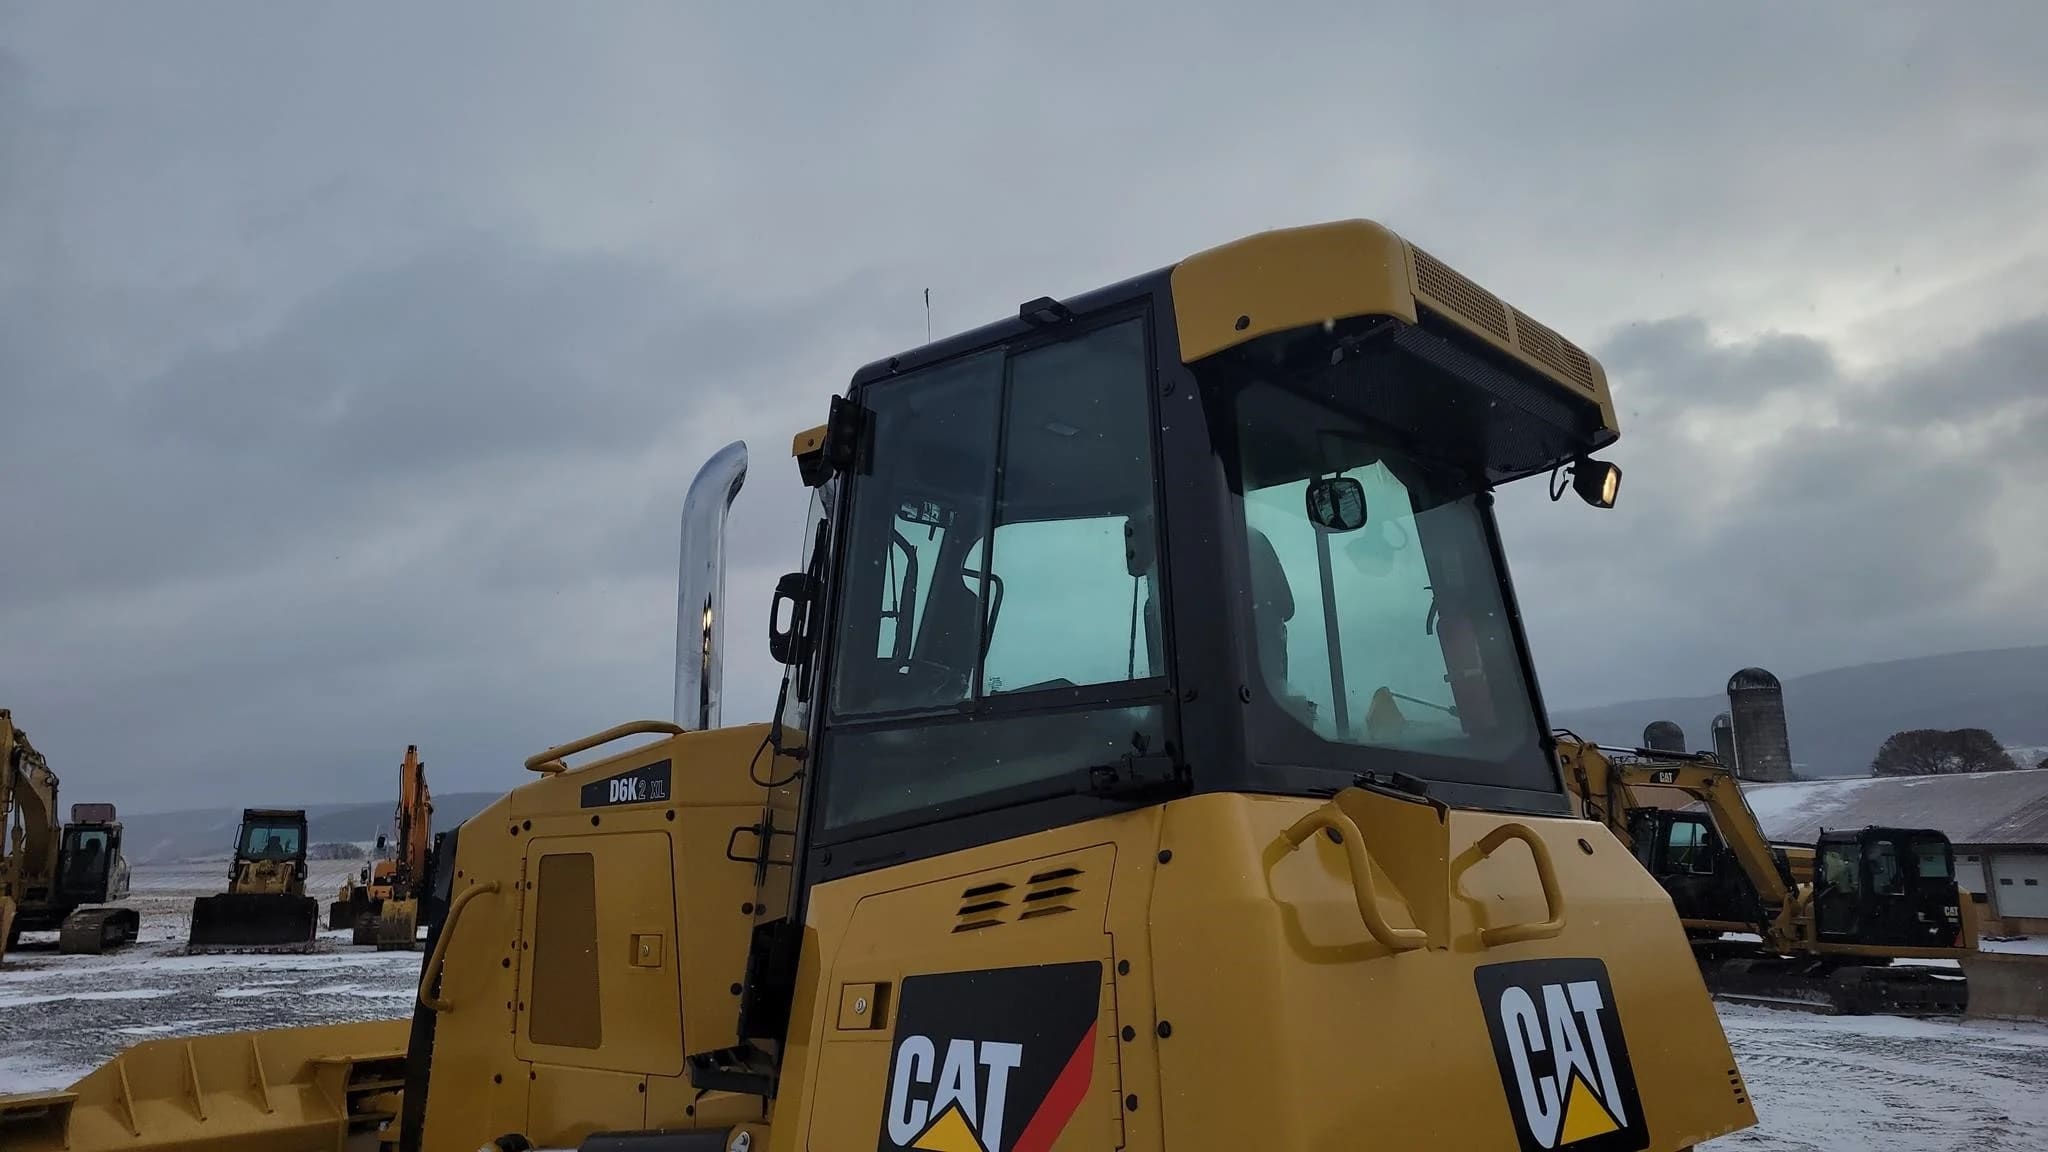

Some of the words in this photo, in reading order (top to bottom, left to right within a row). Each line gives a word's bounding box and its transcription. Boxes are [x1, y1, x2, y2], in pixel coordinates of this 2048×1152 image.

[1659, 771, 1673, 783] CAT
[650, 780, 666, 799] XL
[1944, 906, 1959, 917] CAT
[1500, 981, 1628, 1149] CAT
[888, 1035, 1023, 1152] CAT
